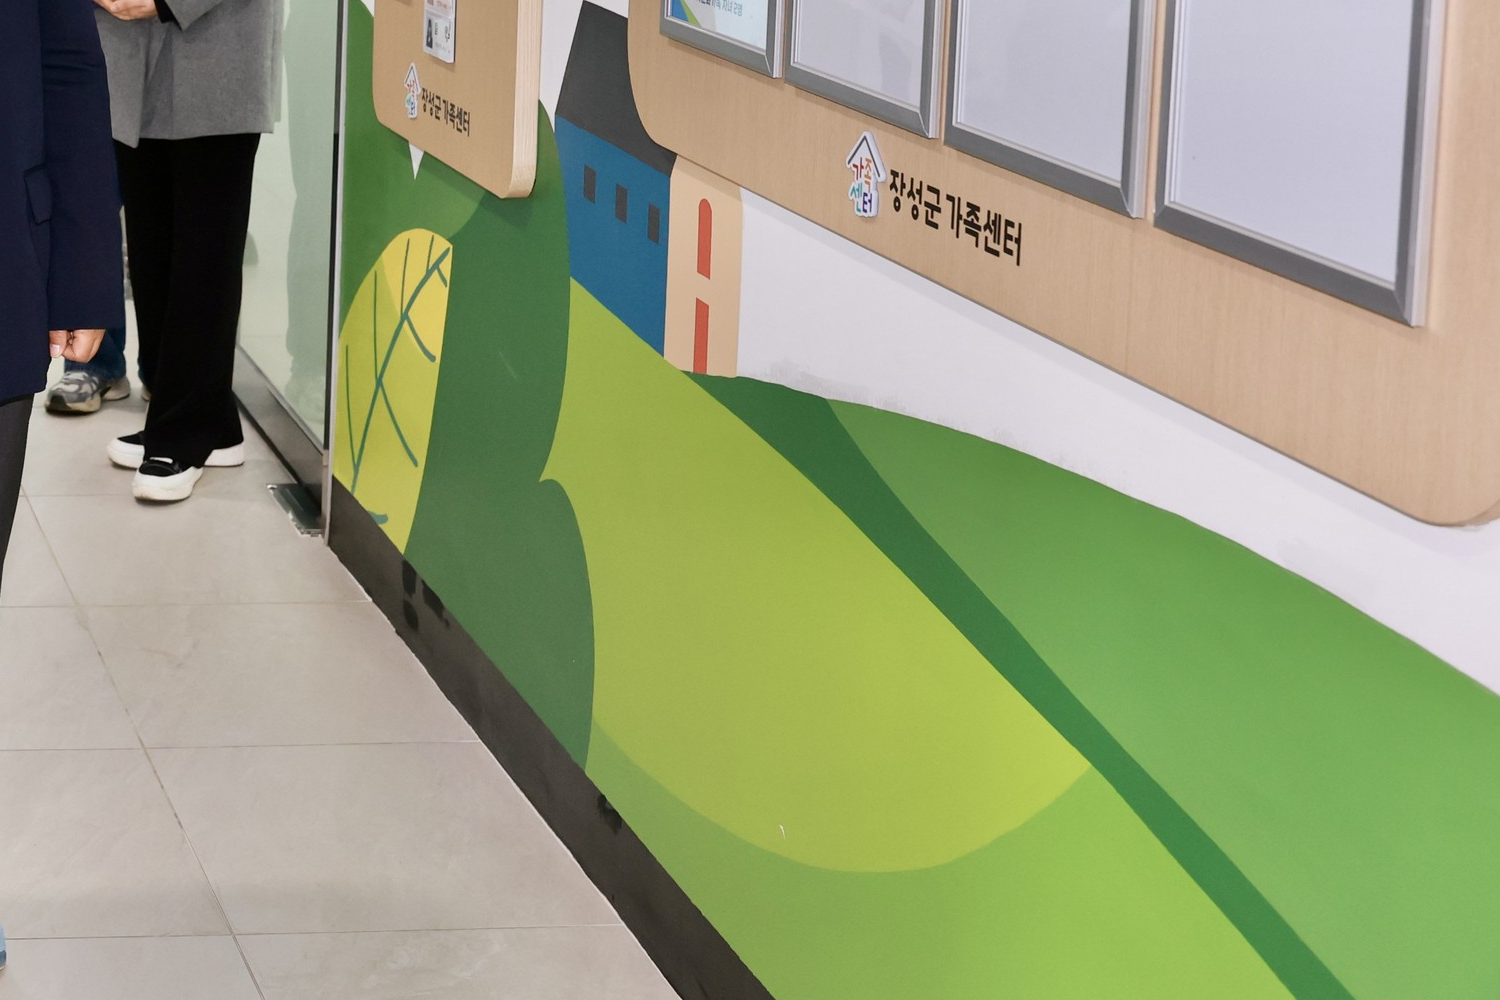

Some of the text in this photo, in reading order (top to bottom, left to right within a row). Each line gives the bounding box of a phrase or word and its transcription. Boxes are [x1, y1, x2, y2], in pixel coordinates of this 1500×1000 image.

[421, 87, 471, 138] 장성군가족센터
[850, 182, 872, 213] 센터
[853, 157, 872, 194] 가족
[889, 169, 1022, 266] 장성군가족센터
